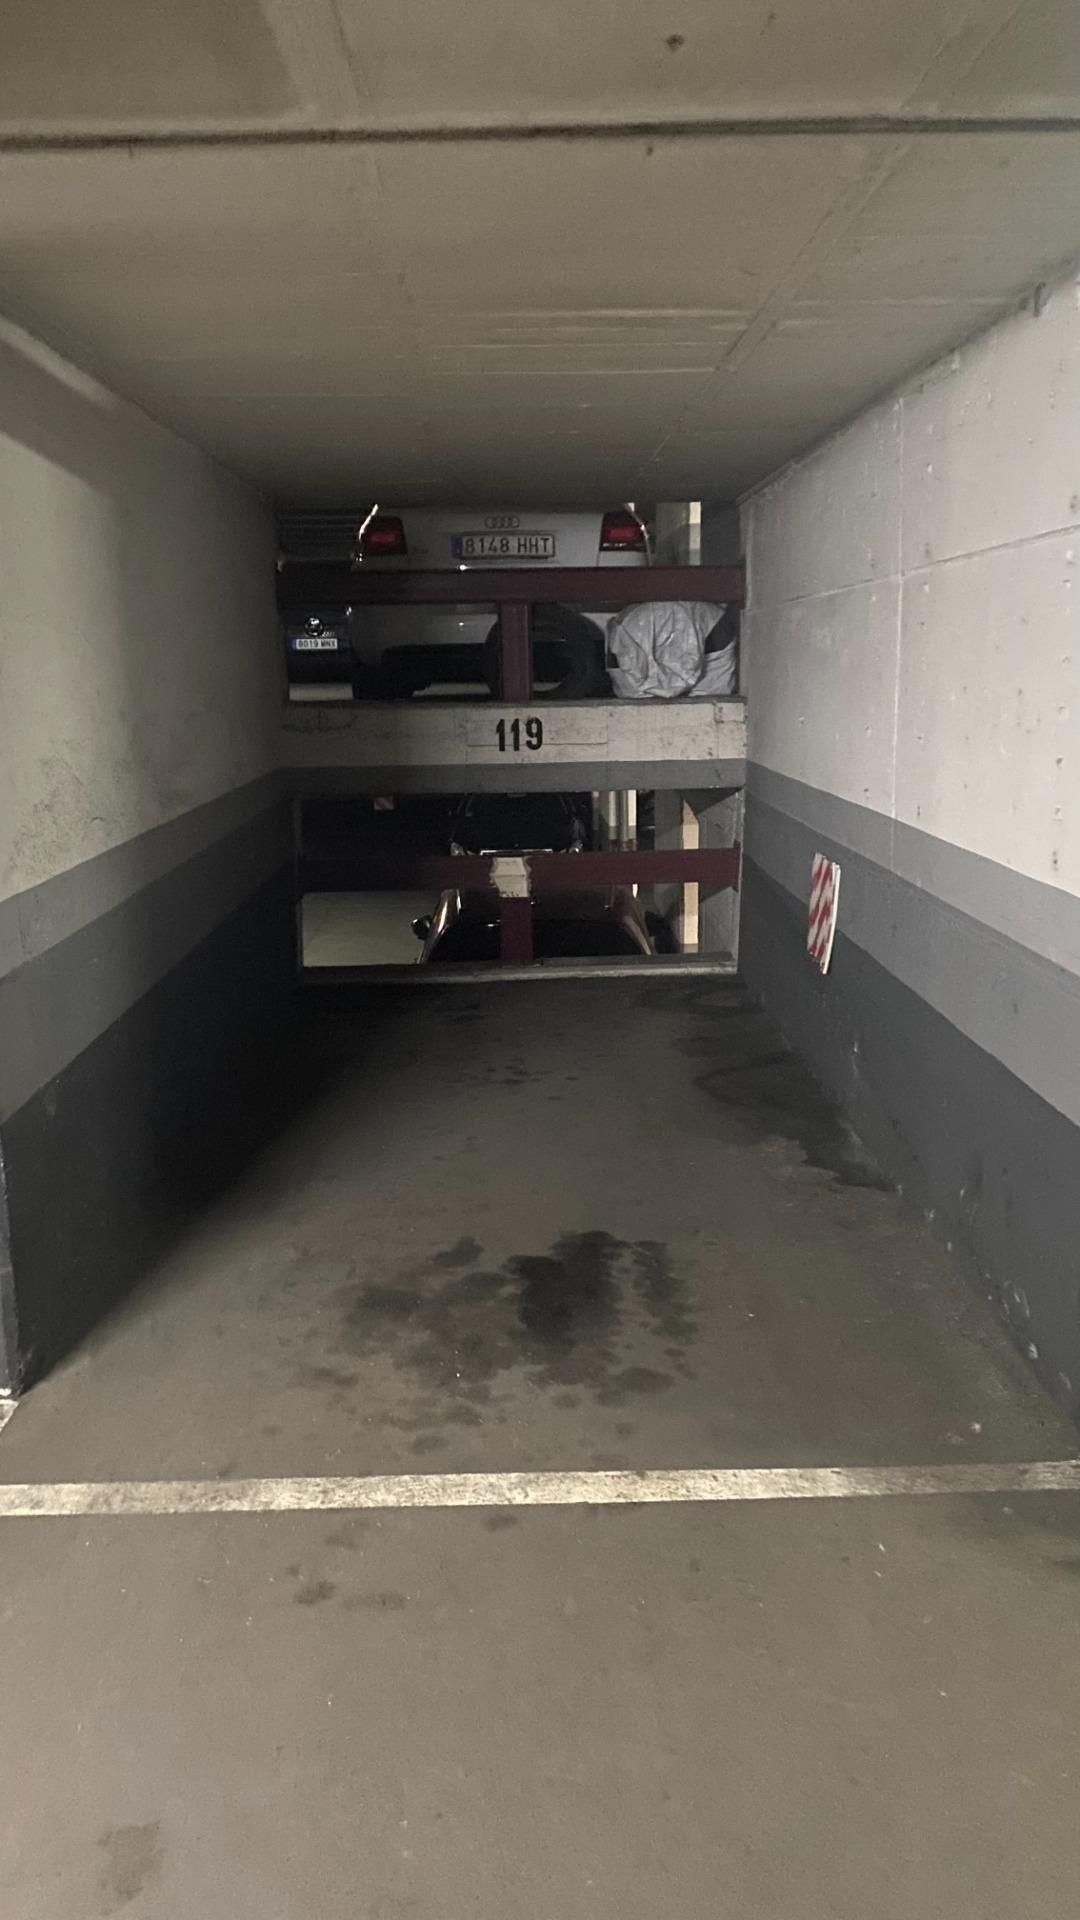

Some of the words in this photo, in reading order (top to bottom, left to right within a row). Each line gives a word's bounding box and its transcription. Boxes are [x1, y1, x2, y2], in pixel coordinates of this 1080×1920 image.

[465, 537, 510, 554] 8148
[517, 537, 550, 553] HHT
[496, 716, 543, 752] 119
